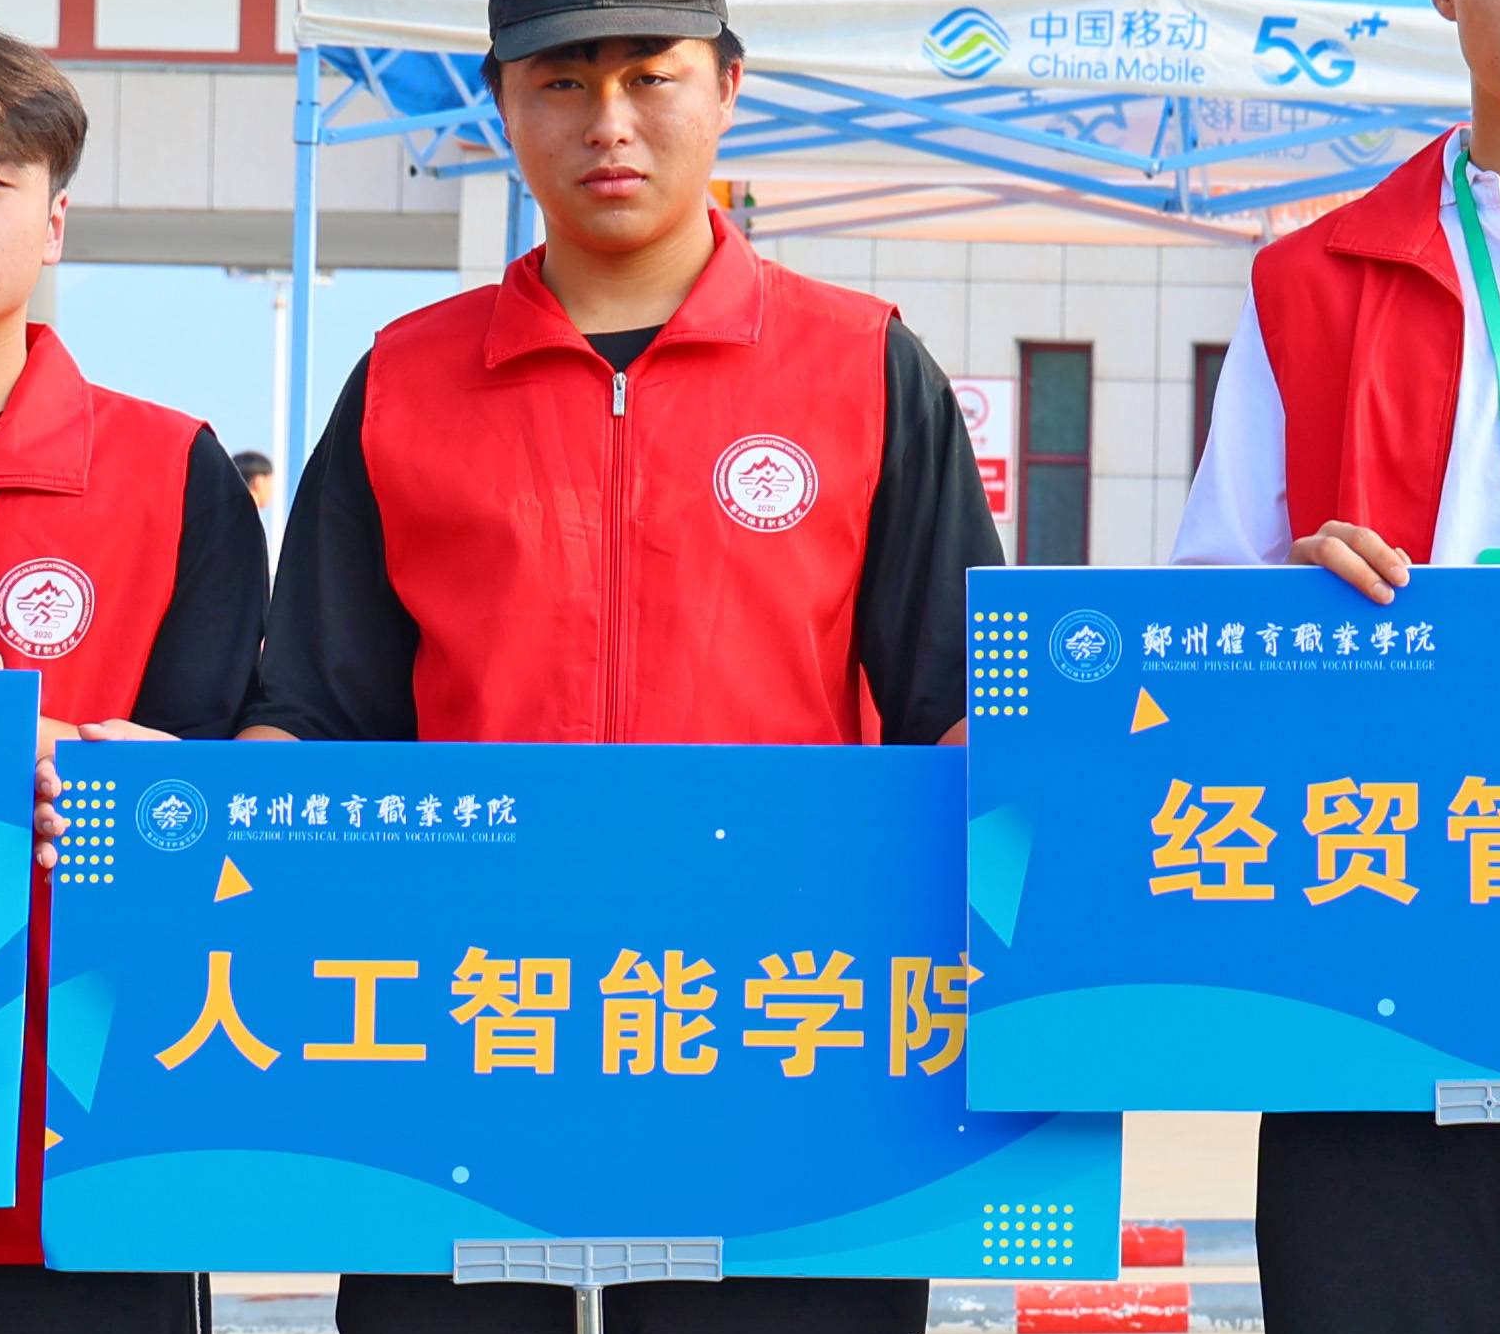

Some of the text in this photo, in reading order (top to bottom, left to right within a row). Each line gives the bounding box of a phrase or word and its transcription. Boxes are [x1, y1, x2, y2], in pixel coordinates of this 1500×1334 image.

[1029, 8, 1208, 51] 中国移动
[1028, 53, 1206, 83] China Mobile
[33, 630, 53, 639] 2020
[1141, 621, 1436, 658] 鄭州體育職業學院
[1142, 660, 1436, 671] ZHENGZHOU PHYSICAL EDUCATION VOCATIONAL COLLEGE
[227, 792, 517, 828] 鄭州體育職業學院
[227, 830, 516, 843] ZHENGZHOU PHYSICAL EDUCATION VOCATIONAL COLLEGE
[155, 947, 967, 1077] 人工智能学院
